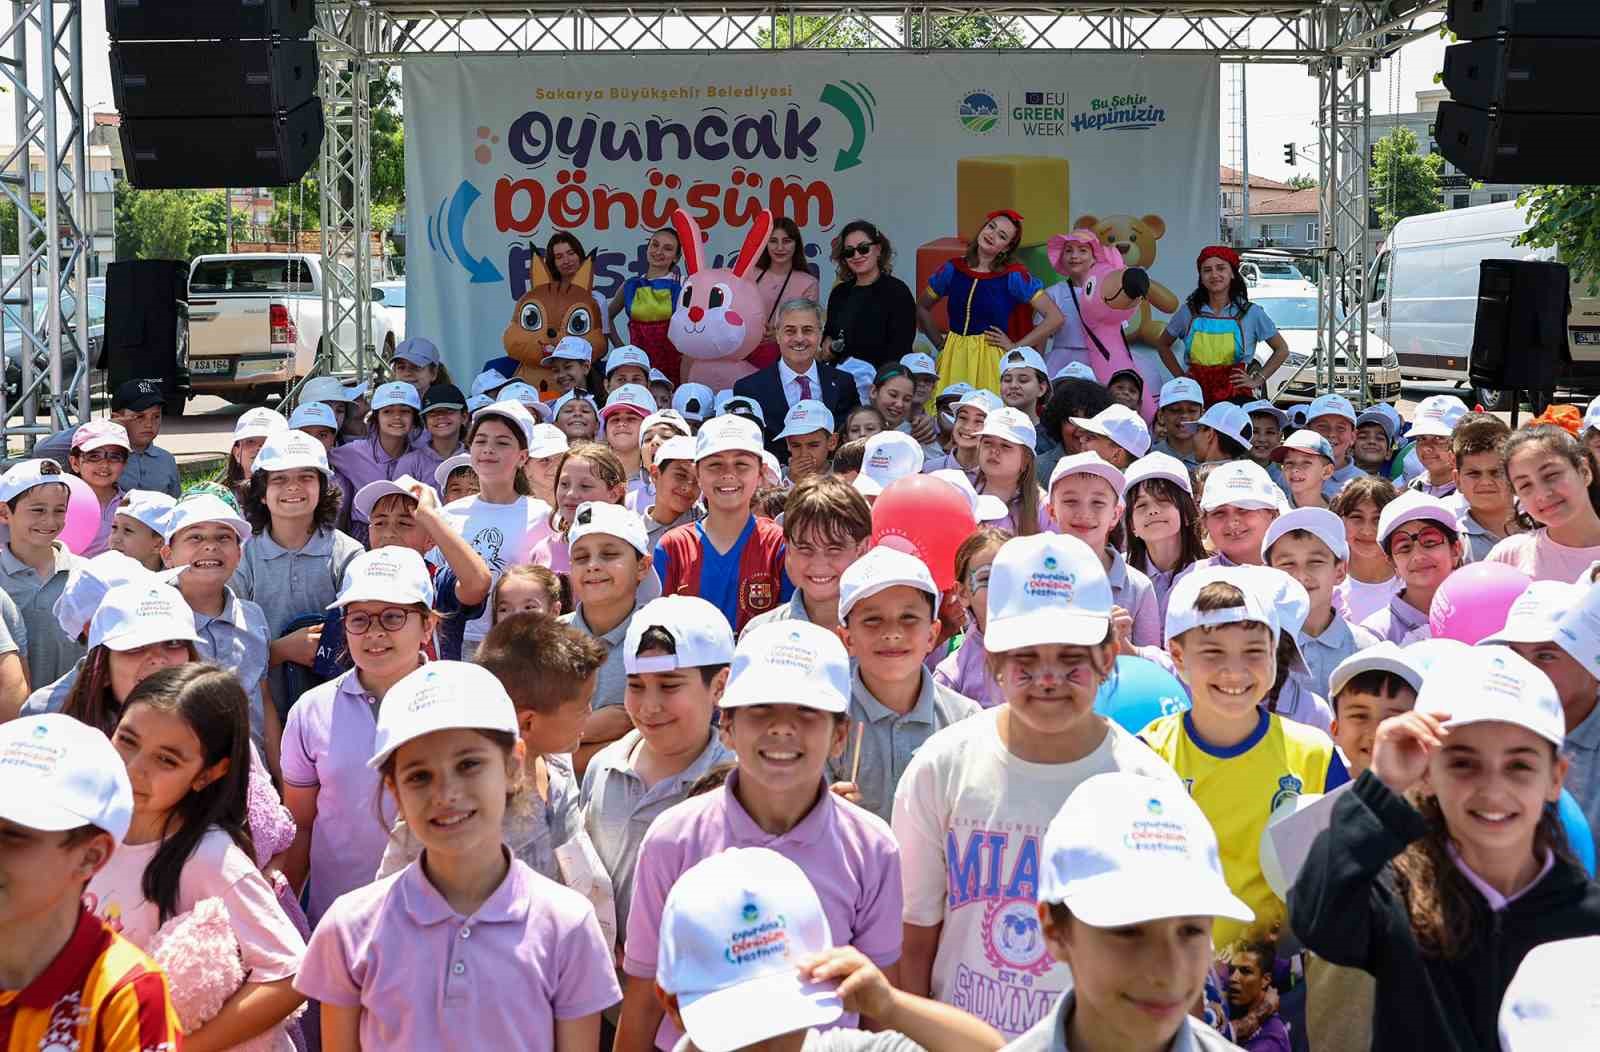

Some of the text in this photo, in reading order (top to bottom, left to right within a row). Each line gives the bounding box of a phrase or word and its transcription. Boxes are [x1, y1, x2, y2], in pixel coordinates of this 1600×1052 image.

[535, 84, 793, 102] Sakarya Büyükşehir Belediyesi
[1046, 92, 1065, 105] EU
[1013, 107, 1065, 120] GREEN
[1090, 98, 1109, 111] Bu
[1071, 105, 1166, 131] Hepimizin
[1023, 122, 1065, 136] WEEK
[508, 108, 822, 169] Oyuncak
[494, 169, 835, 243] Dönüşüm
[947, 827, 1041, 912] MIA
